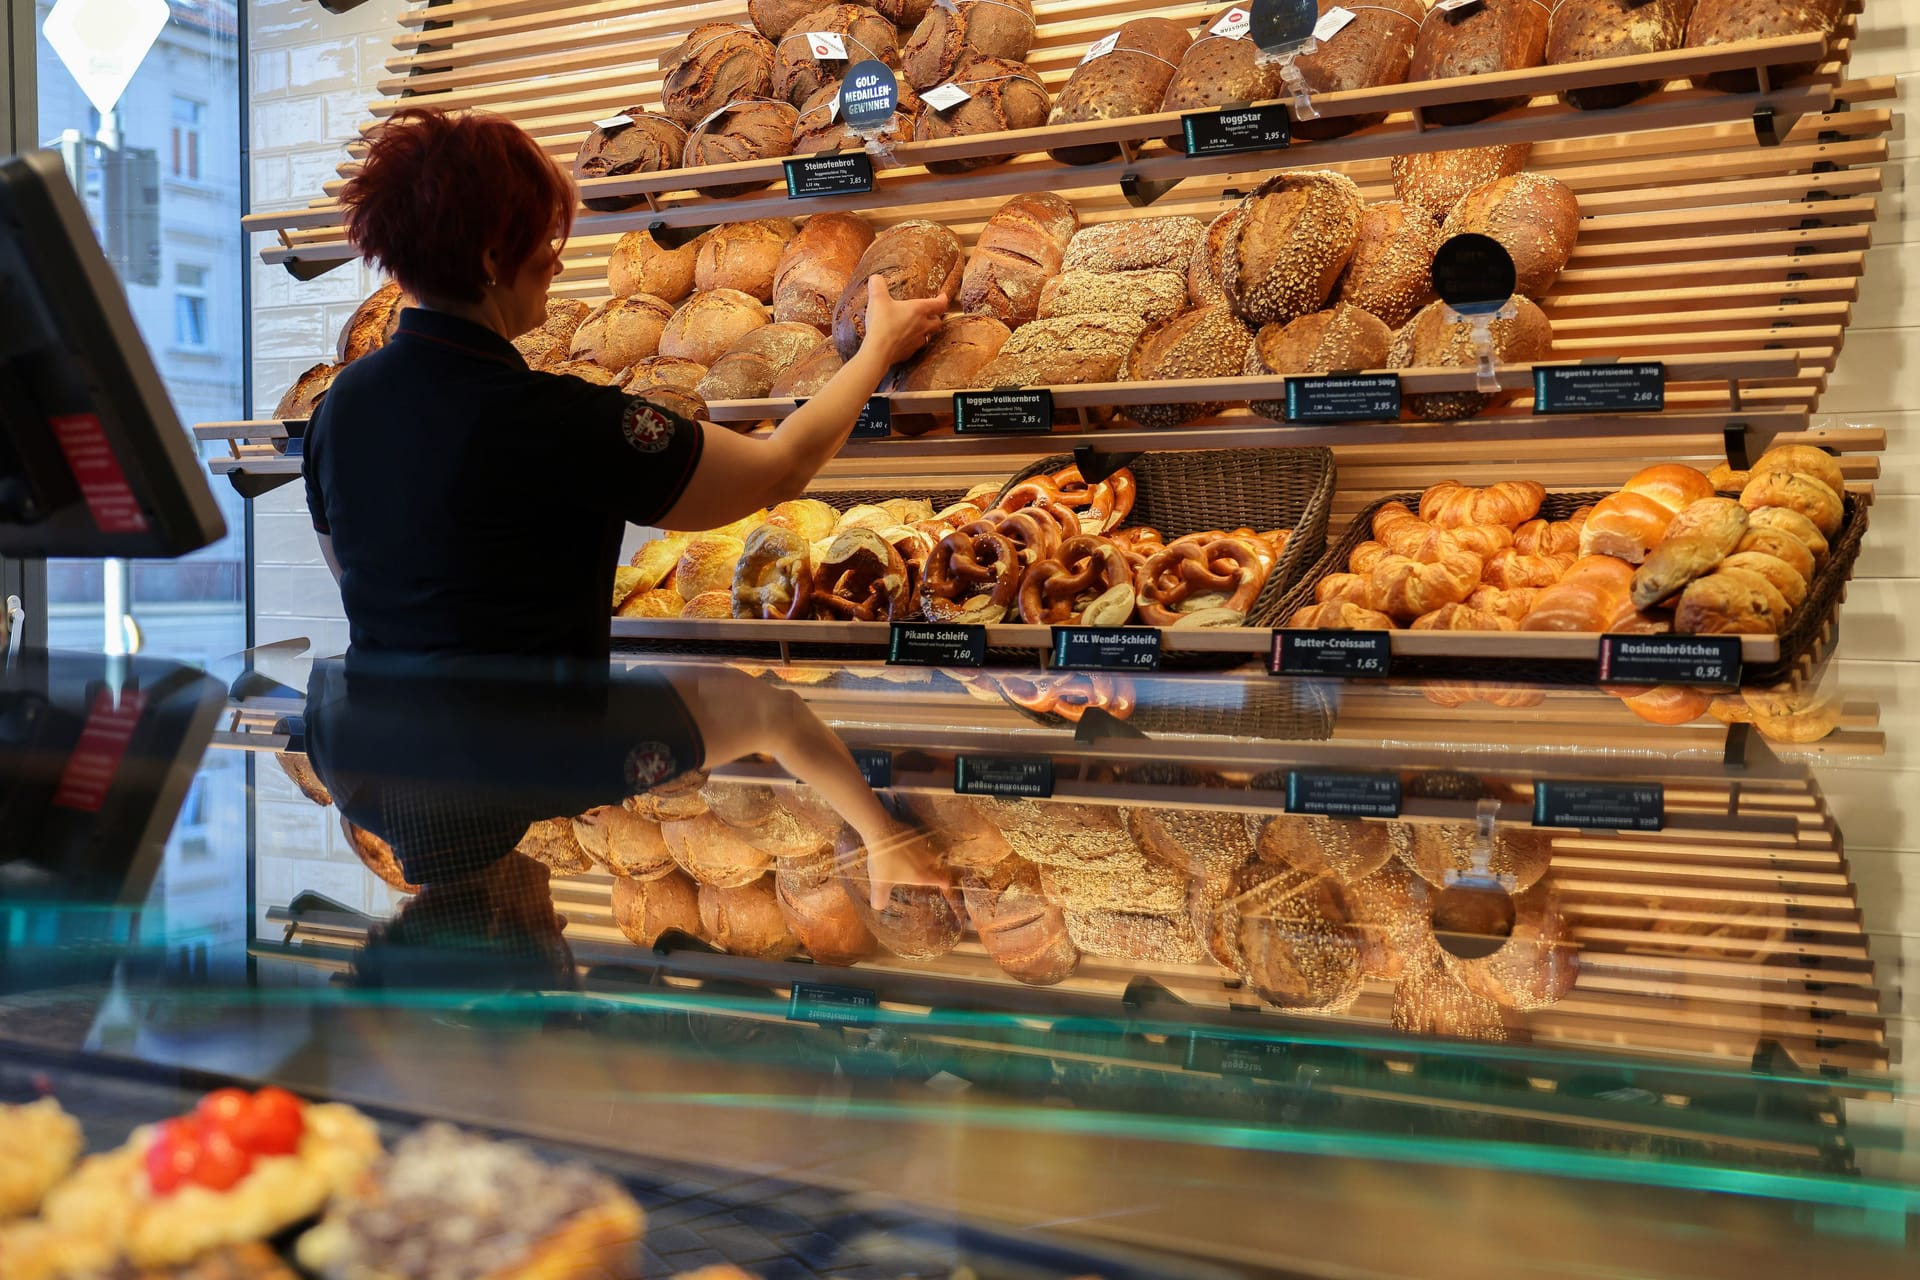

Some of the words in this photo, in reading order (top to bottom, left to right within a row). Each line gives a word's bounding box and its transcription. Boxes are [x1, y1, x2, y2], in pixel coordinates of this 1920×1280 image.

[1220, 22, 1249, 33] OGGSTAR
[855, 75, 880, 88] GOLD-
[845, 84, 892, 103] MEDAILLEN-
[848, 98, 890, 115] GEWINNER
[1220, 113, 1261, 125] RoggStar
[1264, 131, 1279, 141] 3,95
[804, 159, 855, 171] Steinofenbrot
[849, 177, 862, 185] 3,85
[1555, 369, 1590, 379] Baguette
[1592, 368, 1634, 377] Parisienne
[1304, 379, 1376, 389] Hafer-Dinkel-Kruste
[1378, 379, 1396, 388] 500g
[1633, 392, 1652, 402] 2,60
[1373, 401, 1390, 410] 3,95
[1022, 415, 1036, 424] 3,95
[869, 421, 883, 430] 3,40
[905, 630, 934, 640] Pikante
[936, 631, 969, 641] Schleife
[1072, 634, 1089, 644] XXL
[1091, 634, 1157, 645] Wendl-Schleife
[1294, 637, 1376, 649] Butter-Croissant
[953, 649, 971, 660] 1,60
[1620, 642, 1720, 656] Rosinenbrötchen
[1133, 653, 1152, 664] 1,60
[1357, 658, 1378, 670] 1,65
[1695, 665, 1721, 679] 0,95
